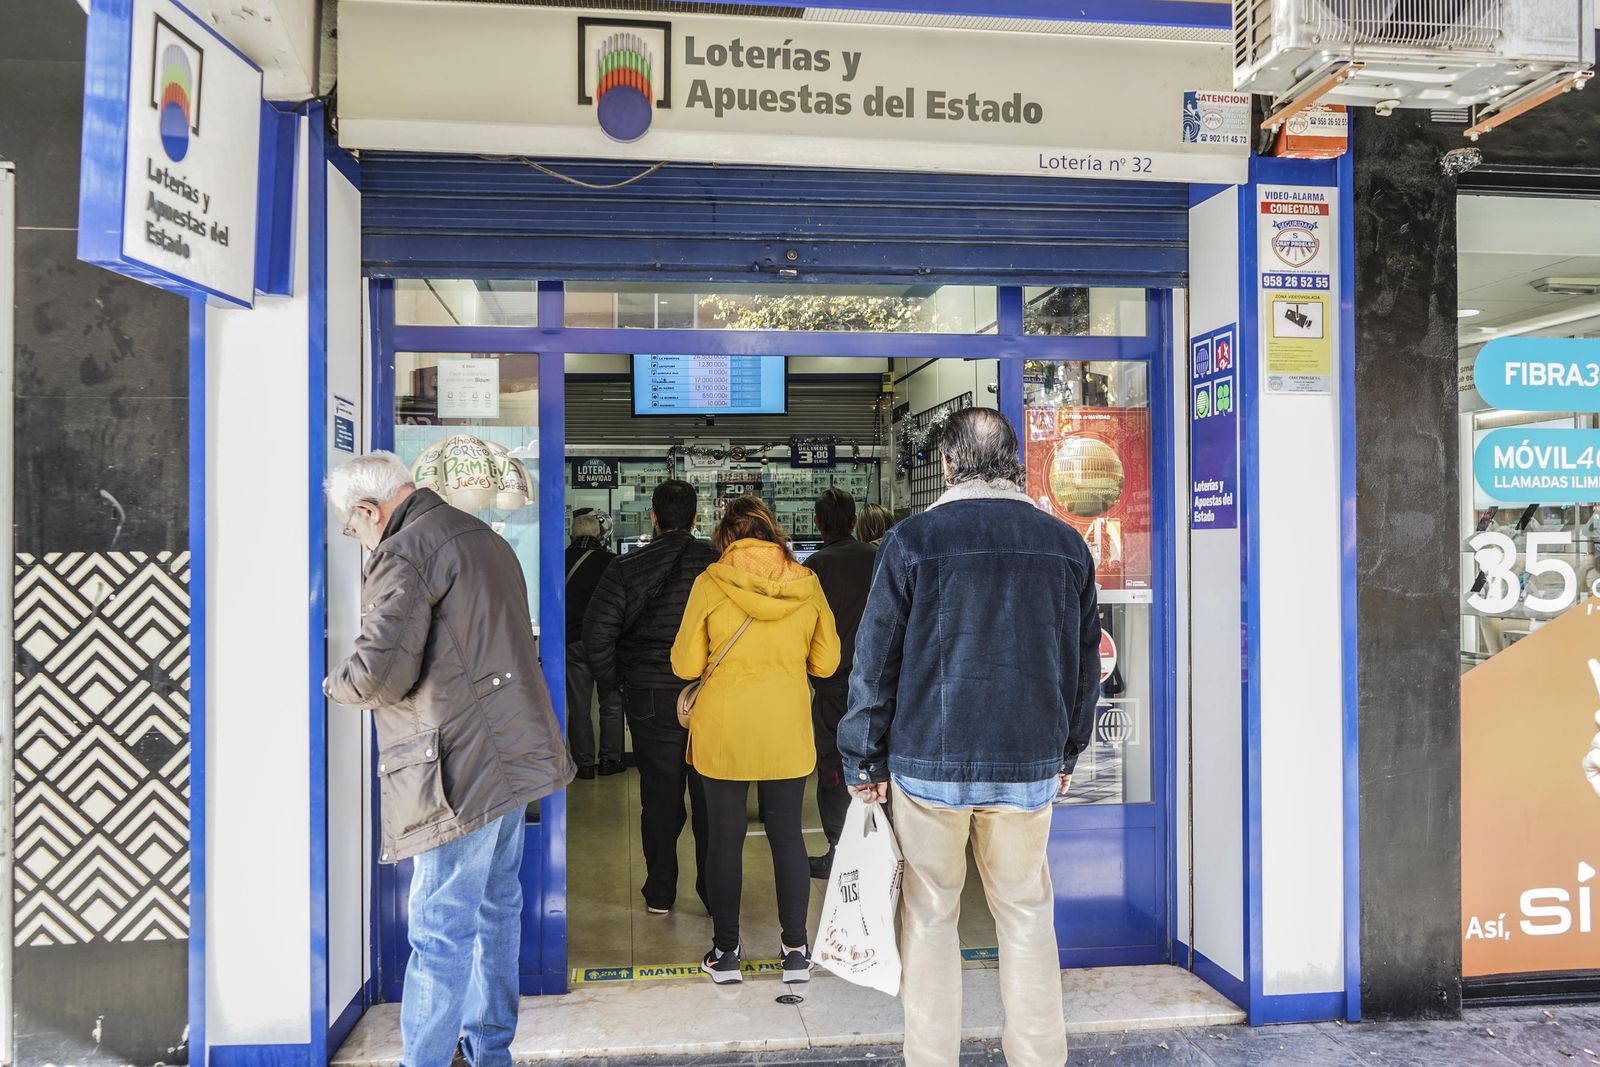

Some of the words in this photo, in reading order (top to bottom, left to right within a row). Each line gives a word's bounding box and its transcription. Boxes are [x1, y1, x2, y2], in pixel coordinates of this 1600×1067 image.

[684, 36, 831, 72] Loterías
[841, 49, 862, 81] y
[686, 79, 852, 117] Apuestas
[863, 86, 914, 118] del
[926, 91, 1043, 124] Estado
[1209, 134, 1220, 142] 902
[1231, 135, 1238, 143] 45
[1039, 153, 1102, 172] Lotería
[1109, 157, 1126, 172] nº
[1132, 157, 1153, 173] 32
[147, 158, 199, 203] Loterías
[203, 193, 210, 214] y
[1265, 191, 1325, 201] VIDEO-ALARMA
[1270, 203, 1320, 214] CONECTADA
[147, 191, 206, 236] Apuestas
[210, 221, 229, 247] del
[146, 221, 190, 258] Estado
[1263, 275, 1282, 287] 958
[1285, 276, 1298, 287] 26
[1300, 276, 1313, 288] 52
[1315, 277, 1329, 288] 55
[1505, 362, 1600, 387] FIBRA3
[577, 463, 612, 475] LOTERÍA
[1194, 478, 1219, 492] Loterías
[1219, 480, 1224, 493] y
[1494, 475, 1569, 488] LLAMADAS
[1194, 494, 1222, 510] Apuestas
[1222, 492, 1233, 506] del
[1194, 509, 1215, 522] Estado
[1467, 532, 1577, 613] 35
[1465, 913, 1511, 940] Así,
